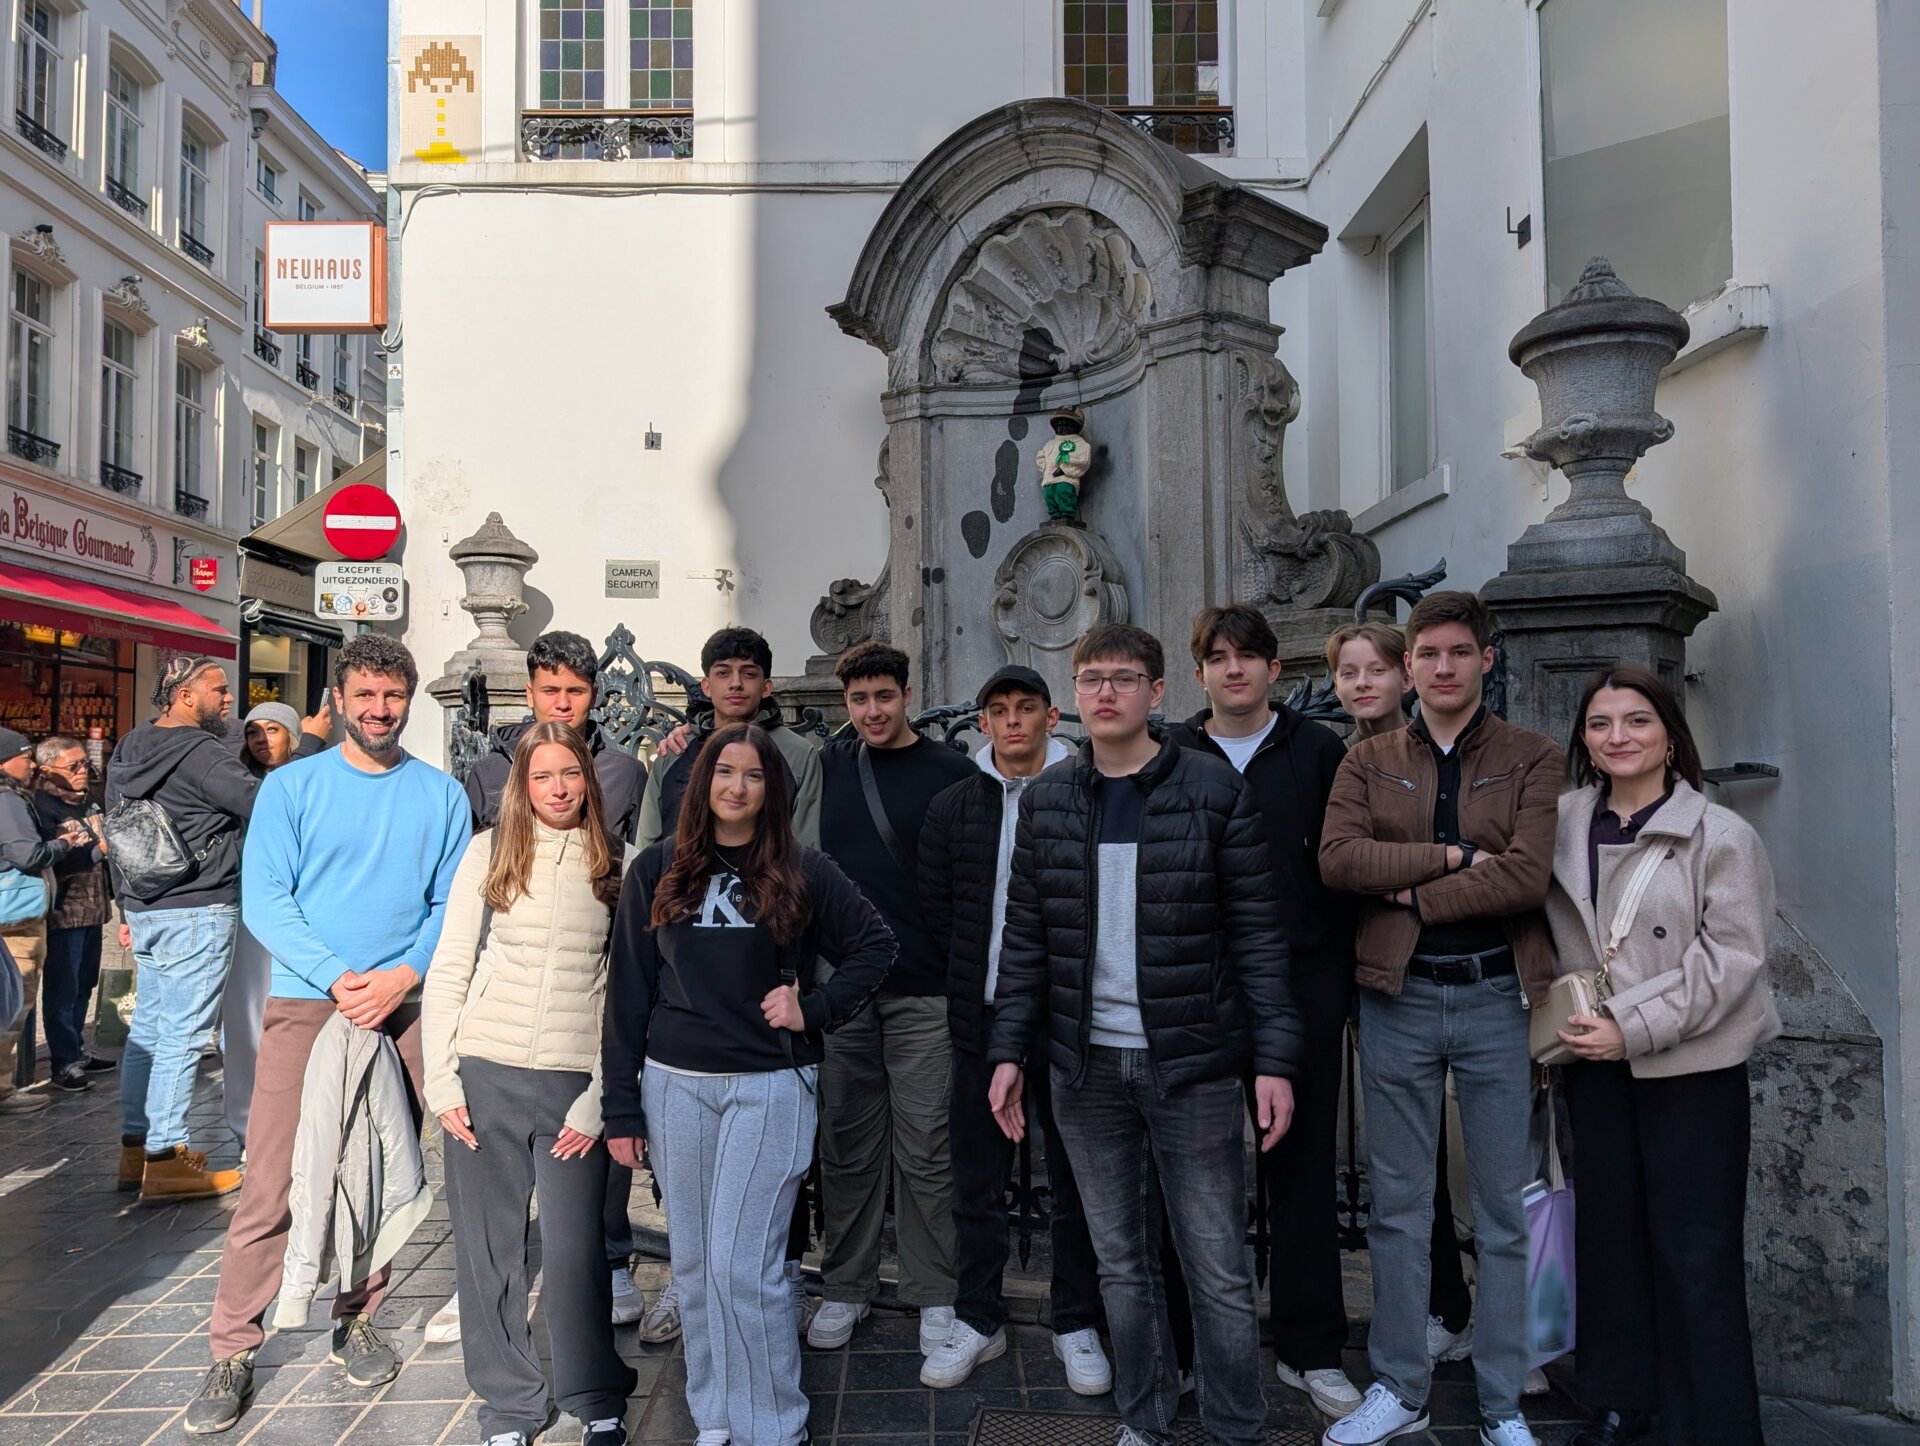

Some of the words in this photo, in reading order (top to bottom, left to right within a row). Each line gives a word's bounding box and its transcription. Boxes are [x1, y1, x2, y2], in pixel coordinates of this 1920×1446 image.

[277, 258, 362, 280] NEUHAUS
[13, 491, 69, 551] Belgique
[73, 518, 136, 567] Gourmande
[337, 566, 382, 574] EXCEPTE
[611, 568, 653, 577] CAMERA
[322, 576, 399, 585] UITGEZONDERD
[607, 580, 658, 589] SECURITY!
